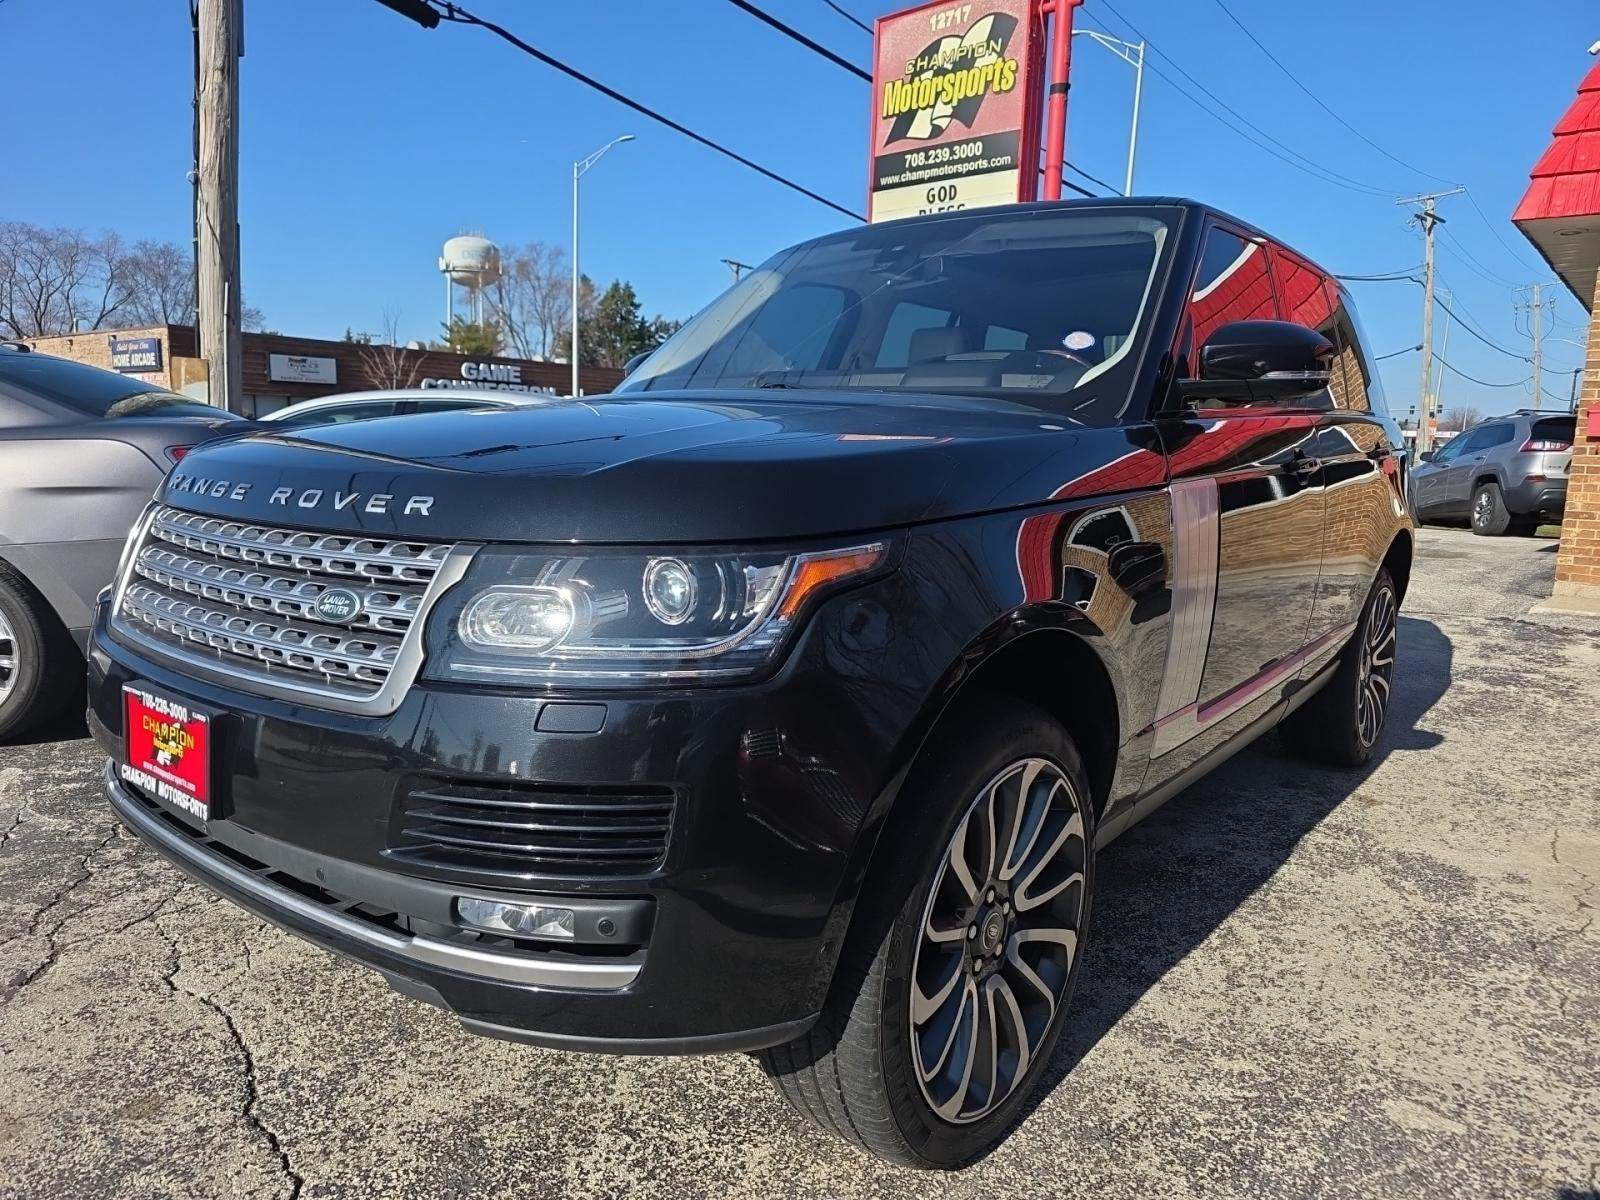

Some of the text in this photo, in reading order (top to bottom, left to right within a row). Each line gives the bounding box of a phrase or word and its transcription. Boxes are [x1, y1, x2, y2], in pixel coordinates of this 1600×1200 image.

[930, 5, 972, 31] 12717
[905, 38, 1002, 75] CHAMPION
[883, 58, 1018, 119] Motorsports
[905, 141, 983, 168] 708.239.3000
[880, 155, 1011, 186] www.champmotorsports.com
[926, 184, 957, 204] GOD
[131, 352, 156, 366] ARCADE
[461, 362, 521, 383] GAME
[168, 473, 435, 516] RANGE ROVER
[323, 603, 350, 616] ROVER
[324, 594, 346, 606] LAND
[143, 715, 195, 750] CHAMPION
[121, 763, 208, 821] CHAMPION MOTORSPORTS
